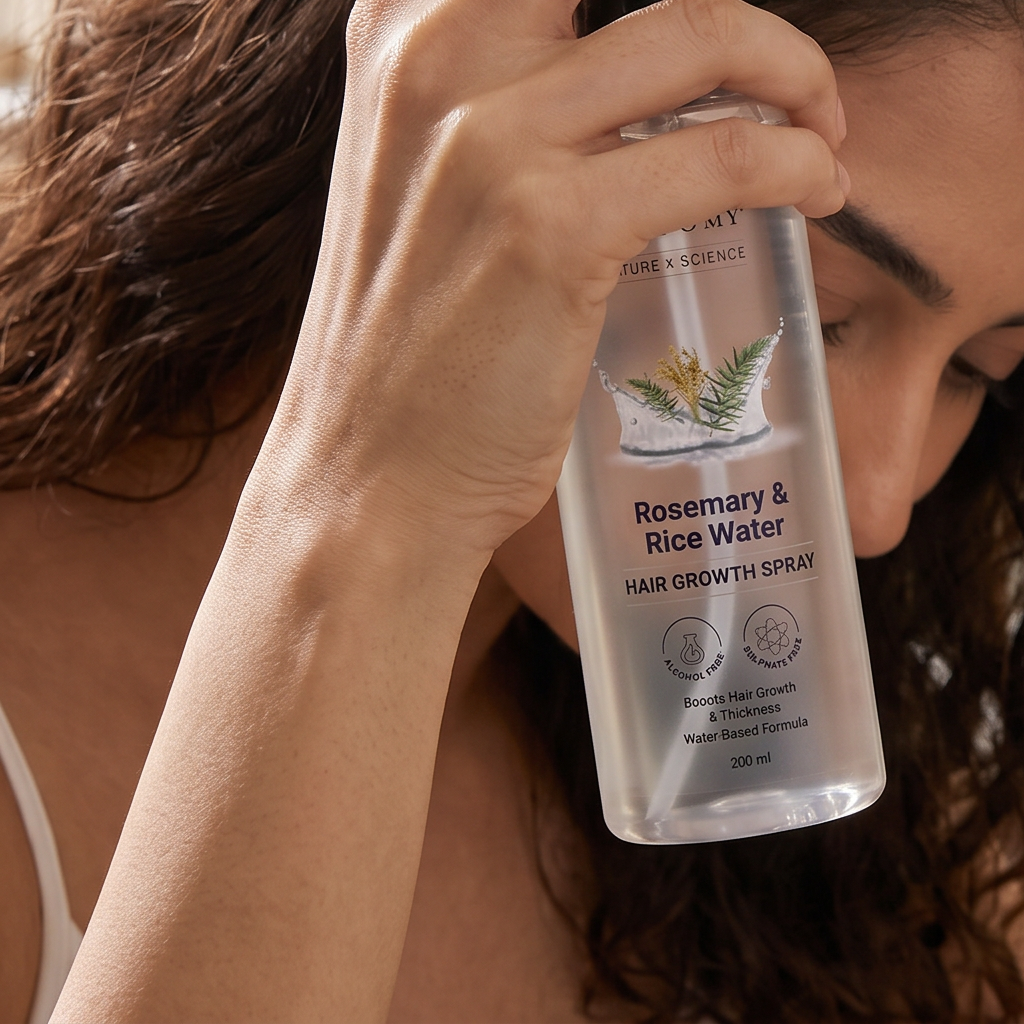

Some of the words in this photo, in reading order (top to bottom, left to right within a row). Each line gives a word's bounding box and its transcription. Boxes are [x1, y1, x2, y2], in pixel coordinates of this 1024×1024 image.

[619, 259, 660, 276] TURE
[680, 246, 746, 267] SCIENCE
[634, 489, 765, 524] Rosemary
[772, 481, 789, 505] &
[645, 529, 703, 555] Rice
[708, 517, 785, 546] Water
[625, 576, 668, 596] HAIR
[672, 563, 757, 592] GROWTH
[761, 552, 815, 577] SPRAY
[664, 659, 706, 681] ALCOHOL
[729, 689, 753, 703] Hair
[756, 681, 797, 698] Growth
[709, 711, 718, 723] &
[720, 702, 782, 721] Thickness
[762, 716, 809, 734] Formula
[730, 755, 753, 770] 200
[756, 751, 772, 764] ml
